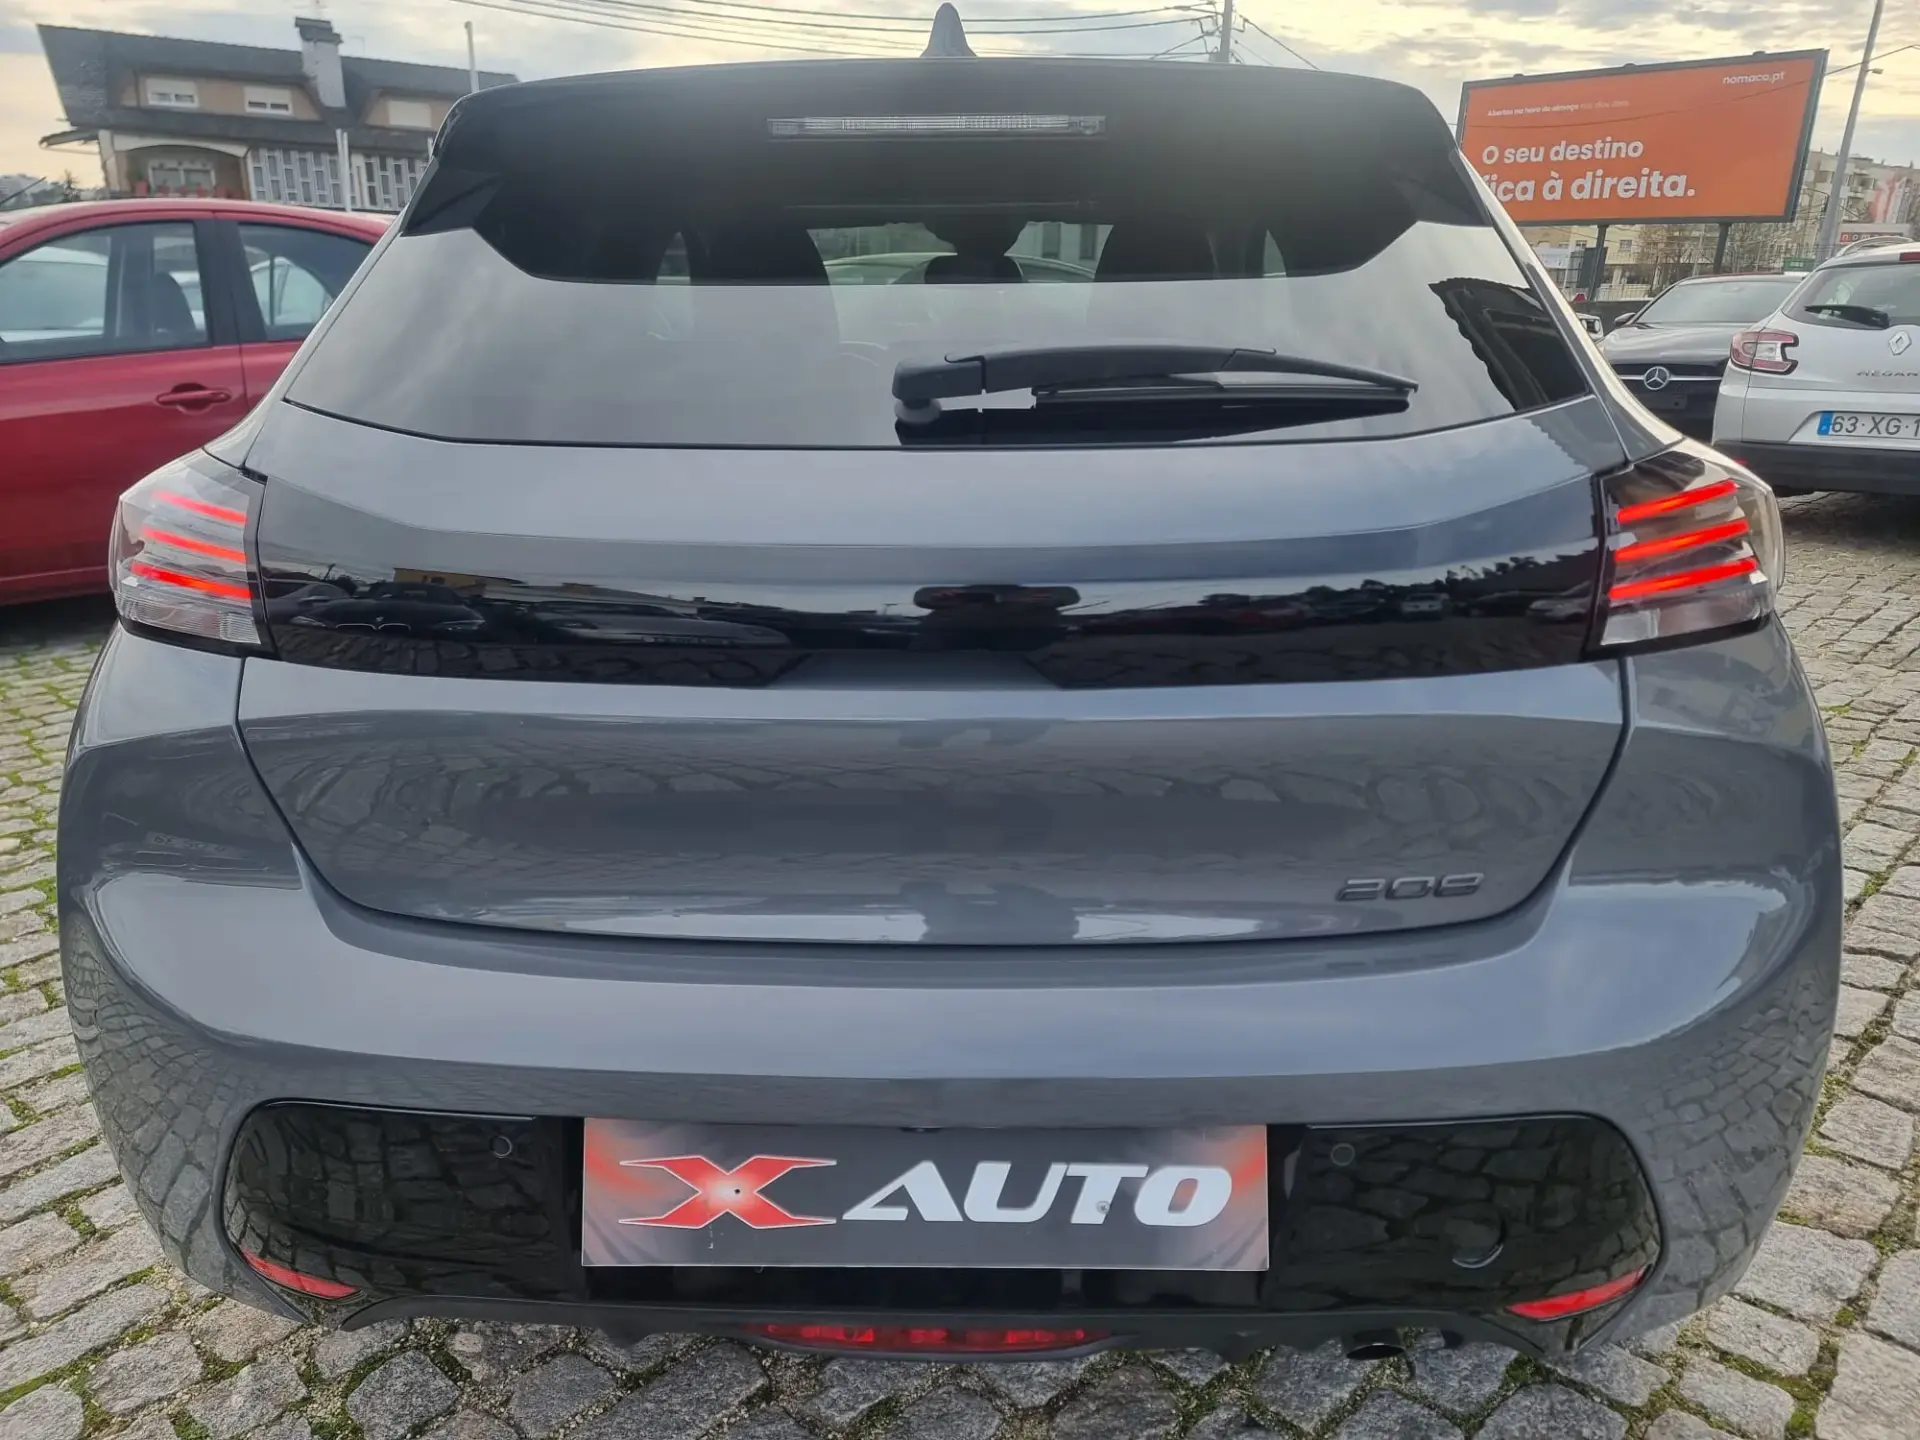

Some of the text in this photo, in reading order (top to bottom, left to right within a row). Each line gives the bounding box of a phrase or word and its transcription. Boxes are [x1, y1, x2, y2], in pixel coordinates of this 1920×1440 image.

[1722, 71, 1787, 84] nomaco.pt
[1482, 136, 1644, 164] O seu destino
[1542, 170, 1564, 201] à
[1570, 168, 1696, 200] direita.
[1335, 872, 1485, 902] 208
[619, 1155, 1234, 1229] X AUTO
